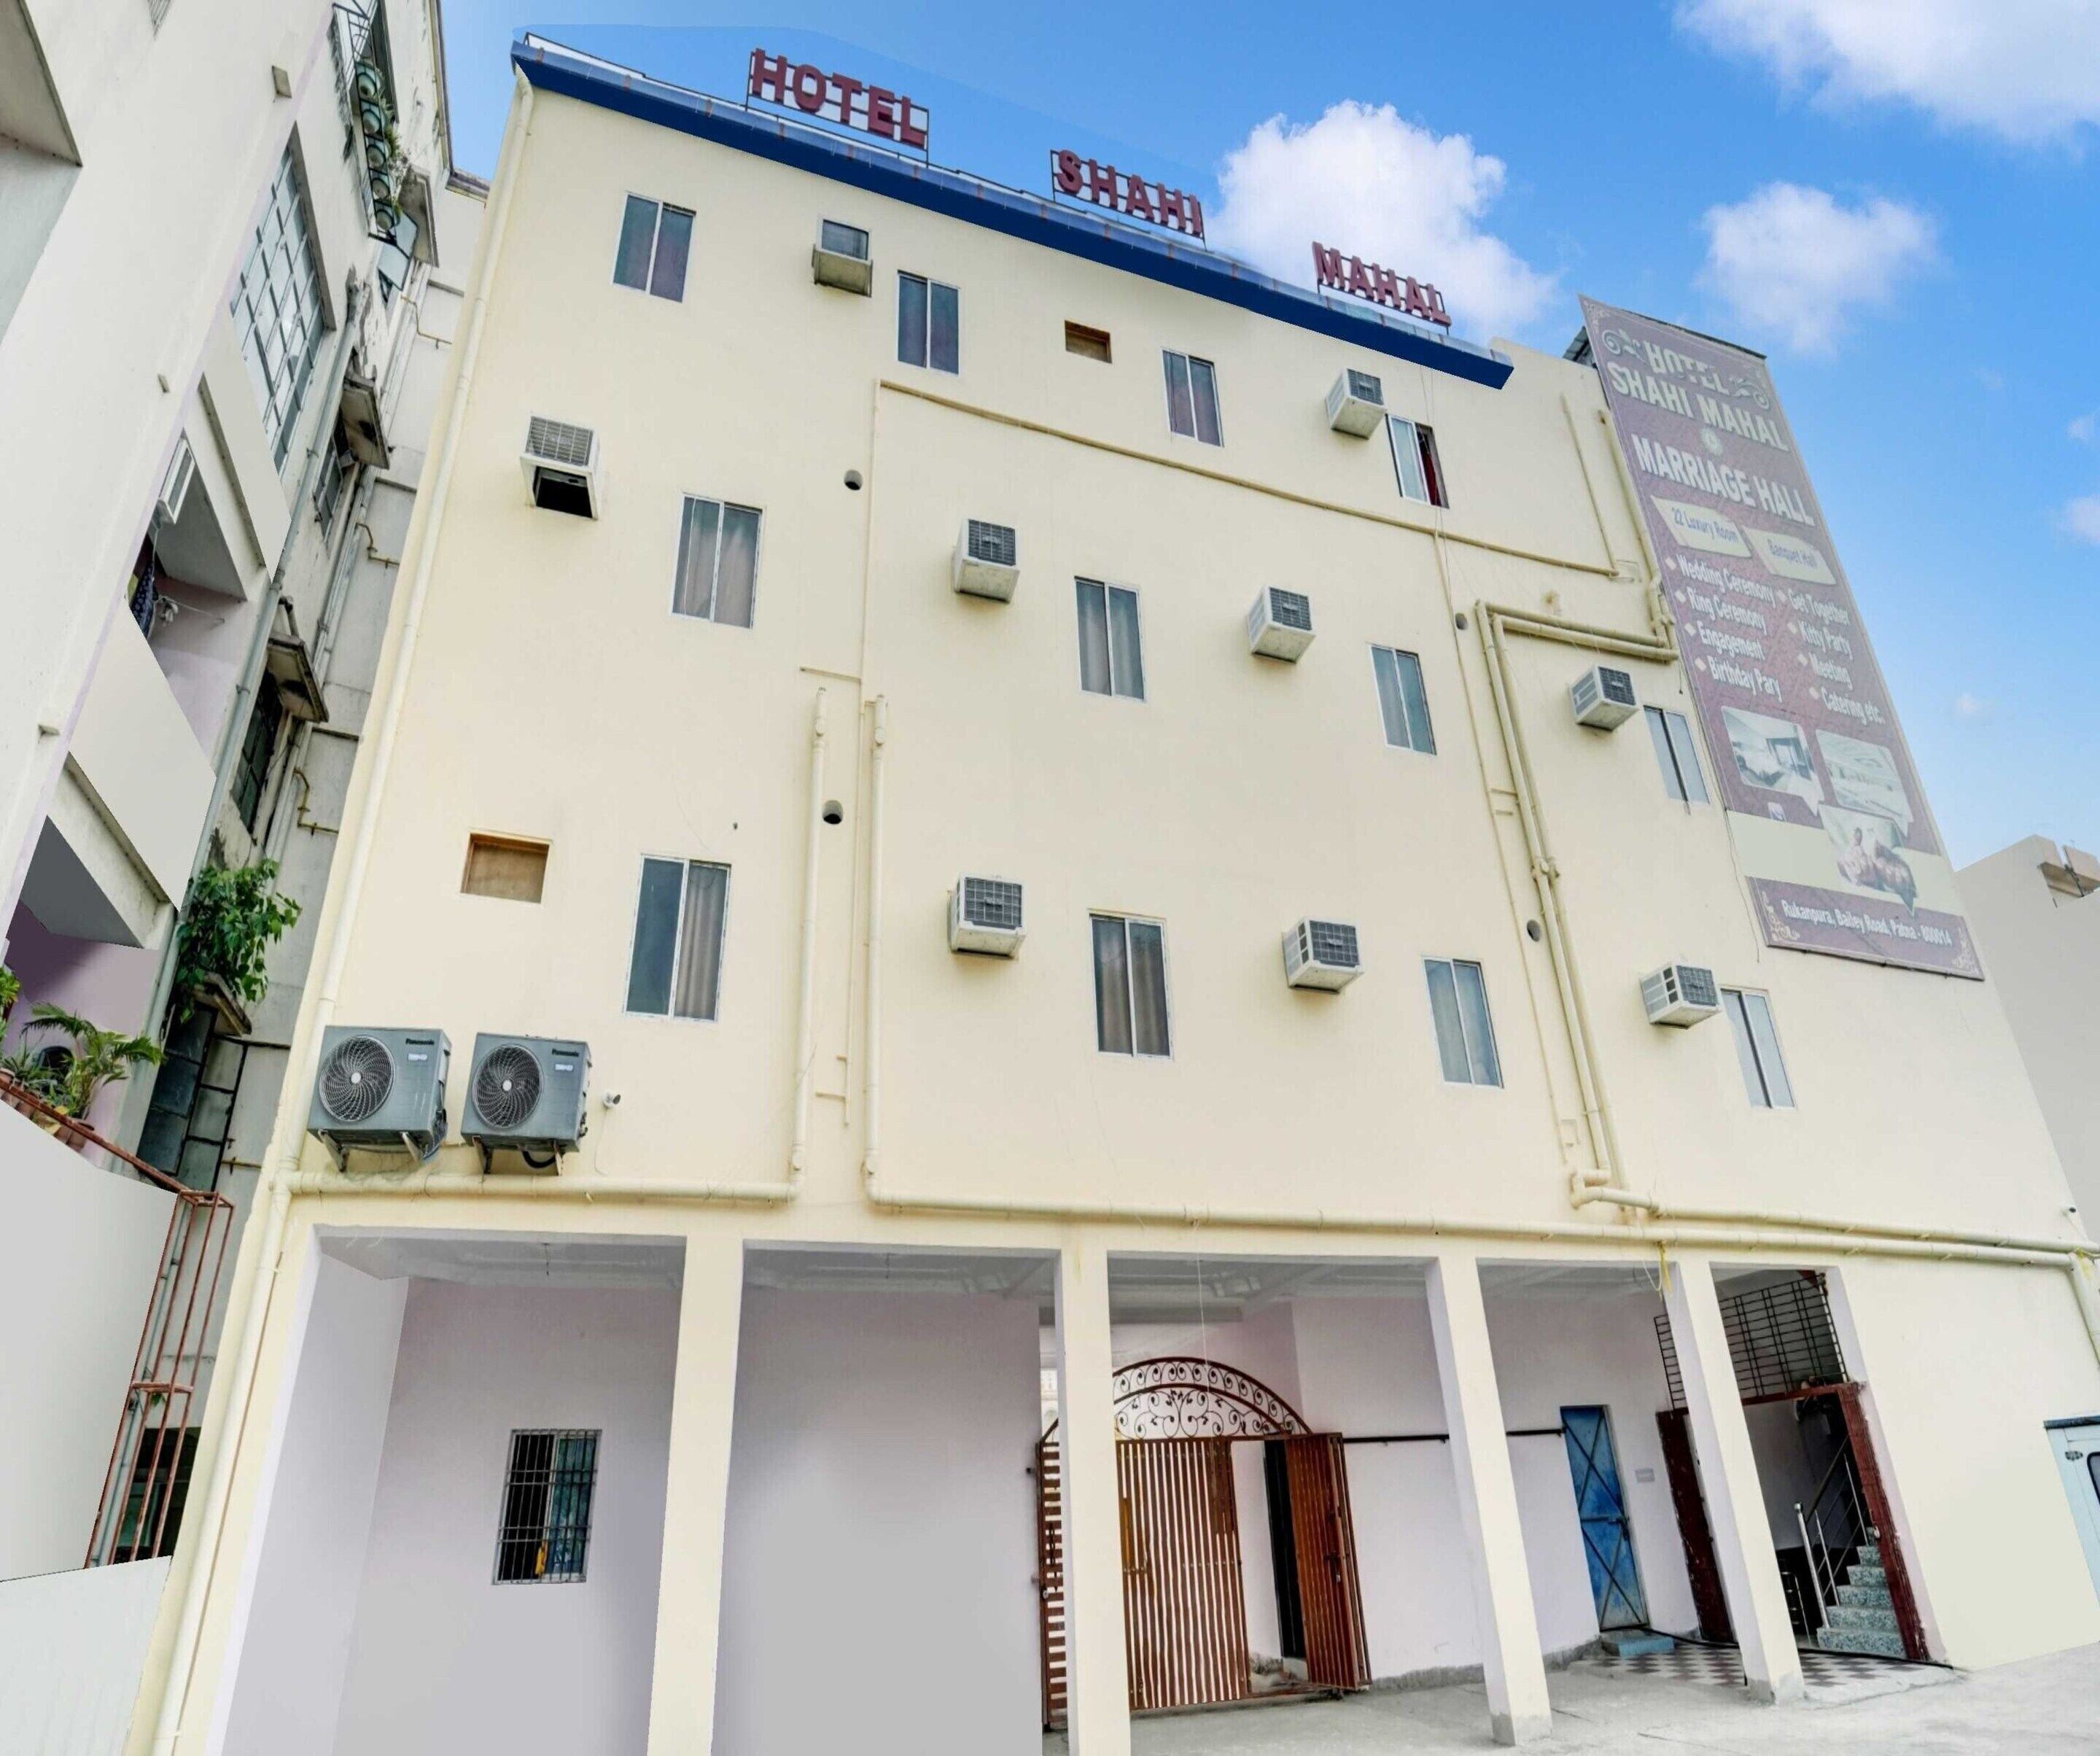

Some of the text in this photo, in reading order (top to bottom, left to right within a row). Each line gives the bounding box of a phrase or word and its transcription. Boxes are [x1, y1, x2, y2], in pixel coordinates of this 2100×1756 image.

[752, 48, 926, 149] HOTEL
[1057, 149, 1202, 238] SHAHI
[1312, 241, 1452, 327] MAHAL
[1644, 340, 1730, 396] HOTEL
[1607, 362, 1789, 451] SHAHI MAHAL
[1632, 434, 1815, 526] MARRIAGE HALL
[1676, 553, 1776, 608] Wedding Ceremony
[1789, 588, 1851, 625] Get Together
[1687, 586, 1767, 636] Ring Ceremony
[1797, 620, 1826, 653] Kitty
[1697, 621, 1765, 661] Engagement
[1707, 656, 1757, 696] Birthday
[1808, 652, 1853, 691] Meeting
[1821, 686, 1867, 726] Catering
